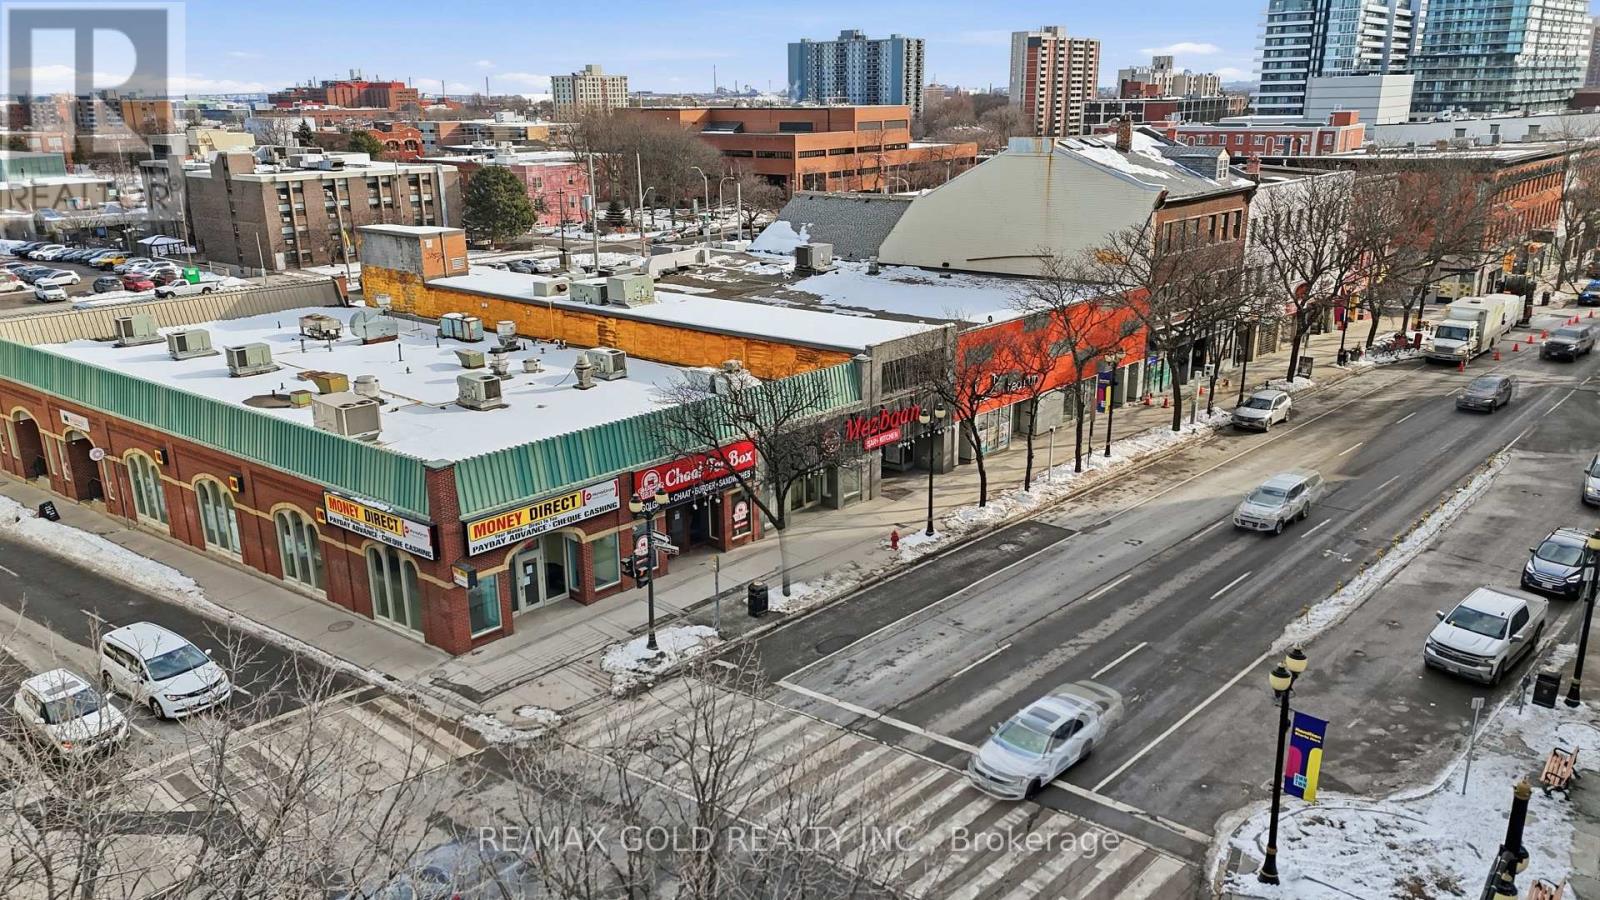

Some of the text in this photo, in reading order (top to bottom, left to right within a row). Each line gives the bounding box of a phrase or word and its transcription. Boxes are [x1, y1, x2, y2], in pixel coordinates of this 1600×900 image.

[845, 403, 920, 442] Mezbaan
[728, 449, 753, 467] Box
[328, 496, 360, 518] MONEY
[364, 509, 399, 533] DIRECT
[673, 489, 692, 502] CHAAT
[472, 501, 618, 554] PAYDAY ADVANCE CHEQUE CASHING
[473, 494, 578, 539] MONEY DIRECT
[329, 516, 351, 529] PAYDAY
[352, 523, 378, 539] ADVANCE
[404, 543, 432, 558] CASHING
